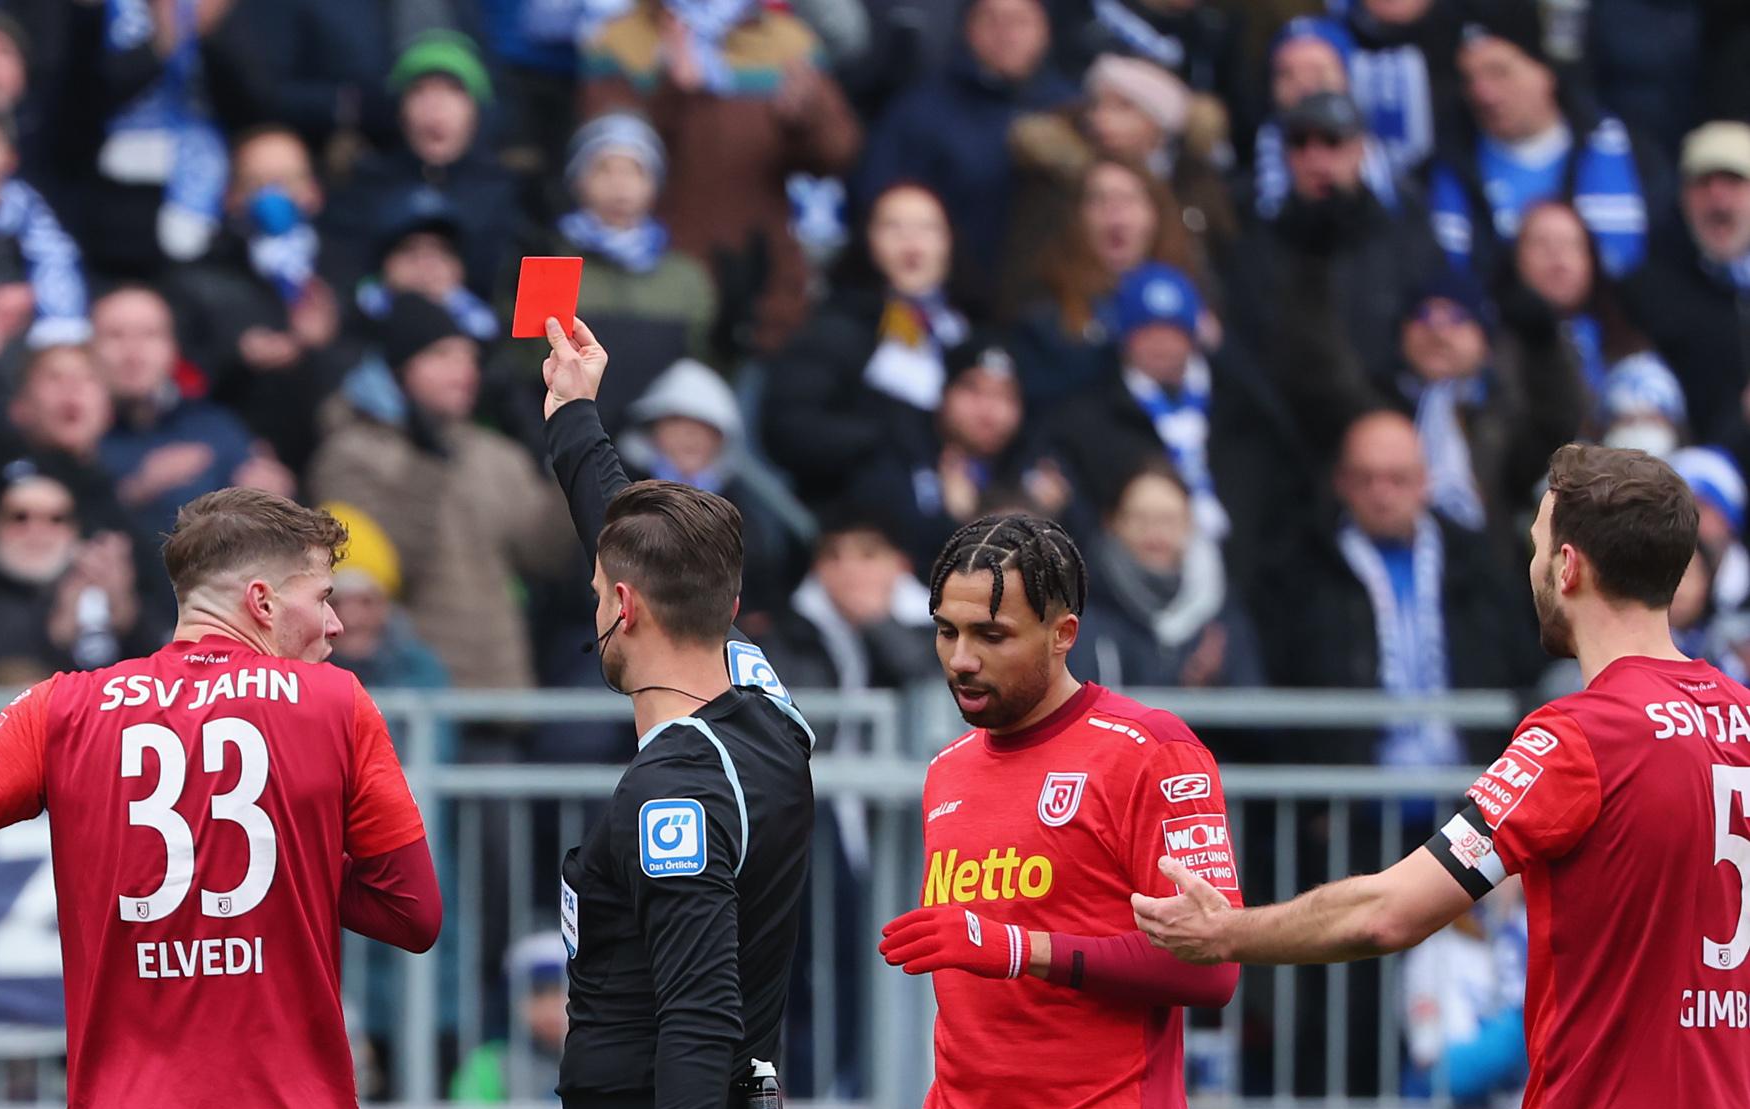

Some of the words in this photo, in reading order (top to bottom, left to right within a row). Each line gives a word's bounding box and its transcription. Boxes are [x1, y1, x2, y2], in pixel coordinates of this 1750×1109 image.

[100, 674, 184, 711] SSV
[187, 667, 299, 710] JAHN
[1644, 700, 1706, 739] SSV
[1706, 704, 1750, 744] JA
[118, 716, 277, 923] 33
[1466, 788, 1503, 815] TUNG
[1167, 824, 1225, 851] WOLF
[649, 862, 663, 871] Das
[665, 859, 699, 870] Örtliche
[924, 847, 1053, 907] Netto
[1702, 763, 1750, 971] 5
[135, 937, 265, 979] ELVEDI
[1680, 989, 1750, 1029] GIMB
